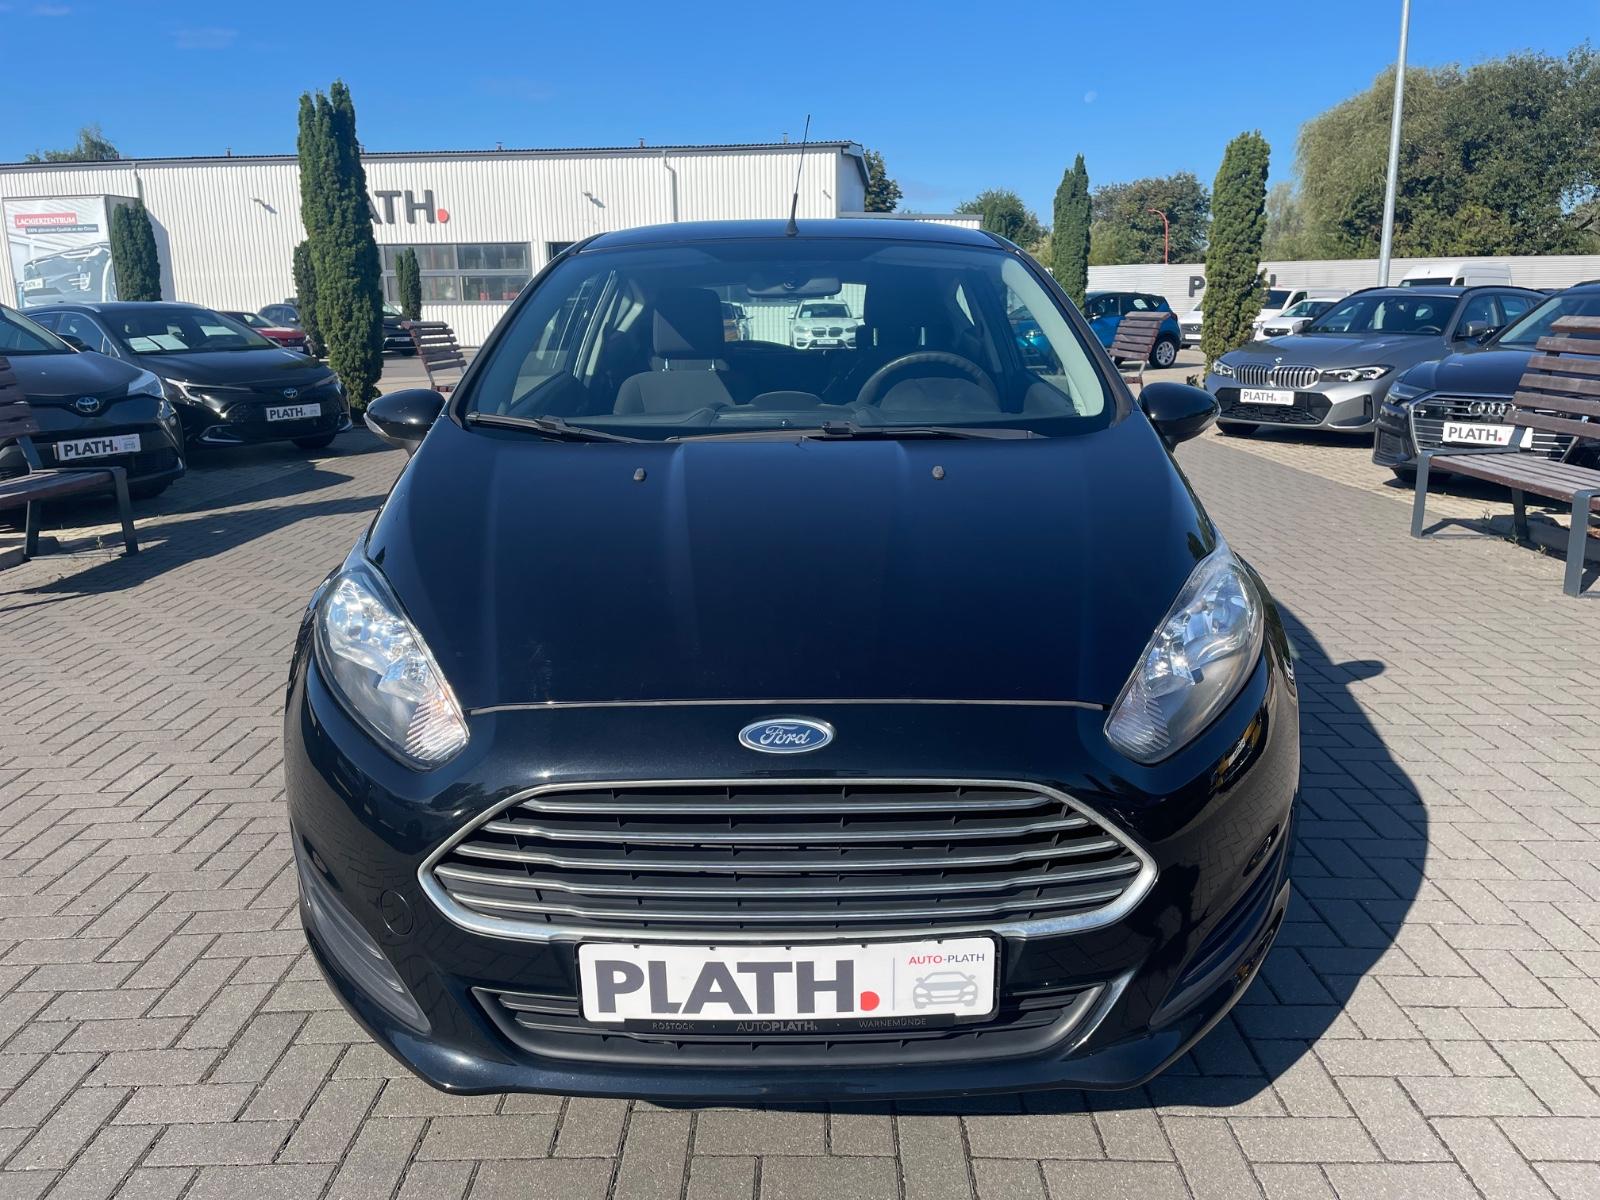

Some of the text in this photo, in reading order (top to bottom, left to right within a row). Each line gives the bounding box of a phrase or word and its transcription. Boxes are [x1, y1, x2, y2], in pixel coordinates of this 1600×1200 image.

[1243, 391, 1277, 402] PLATH.
[269, 407, 306, 419] PLATH.
[1448, 426, 1502, 442] PLATH.
[63, 439, 118, 457] PLATH.
[760, 725, 811, 744] Ford
[908, 953, 985, 966] AUTO-PLATH
[594, 959, 880, 1015] PLATH.
[652, 1022, 695, 1031] ROSTOCK
